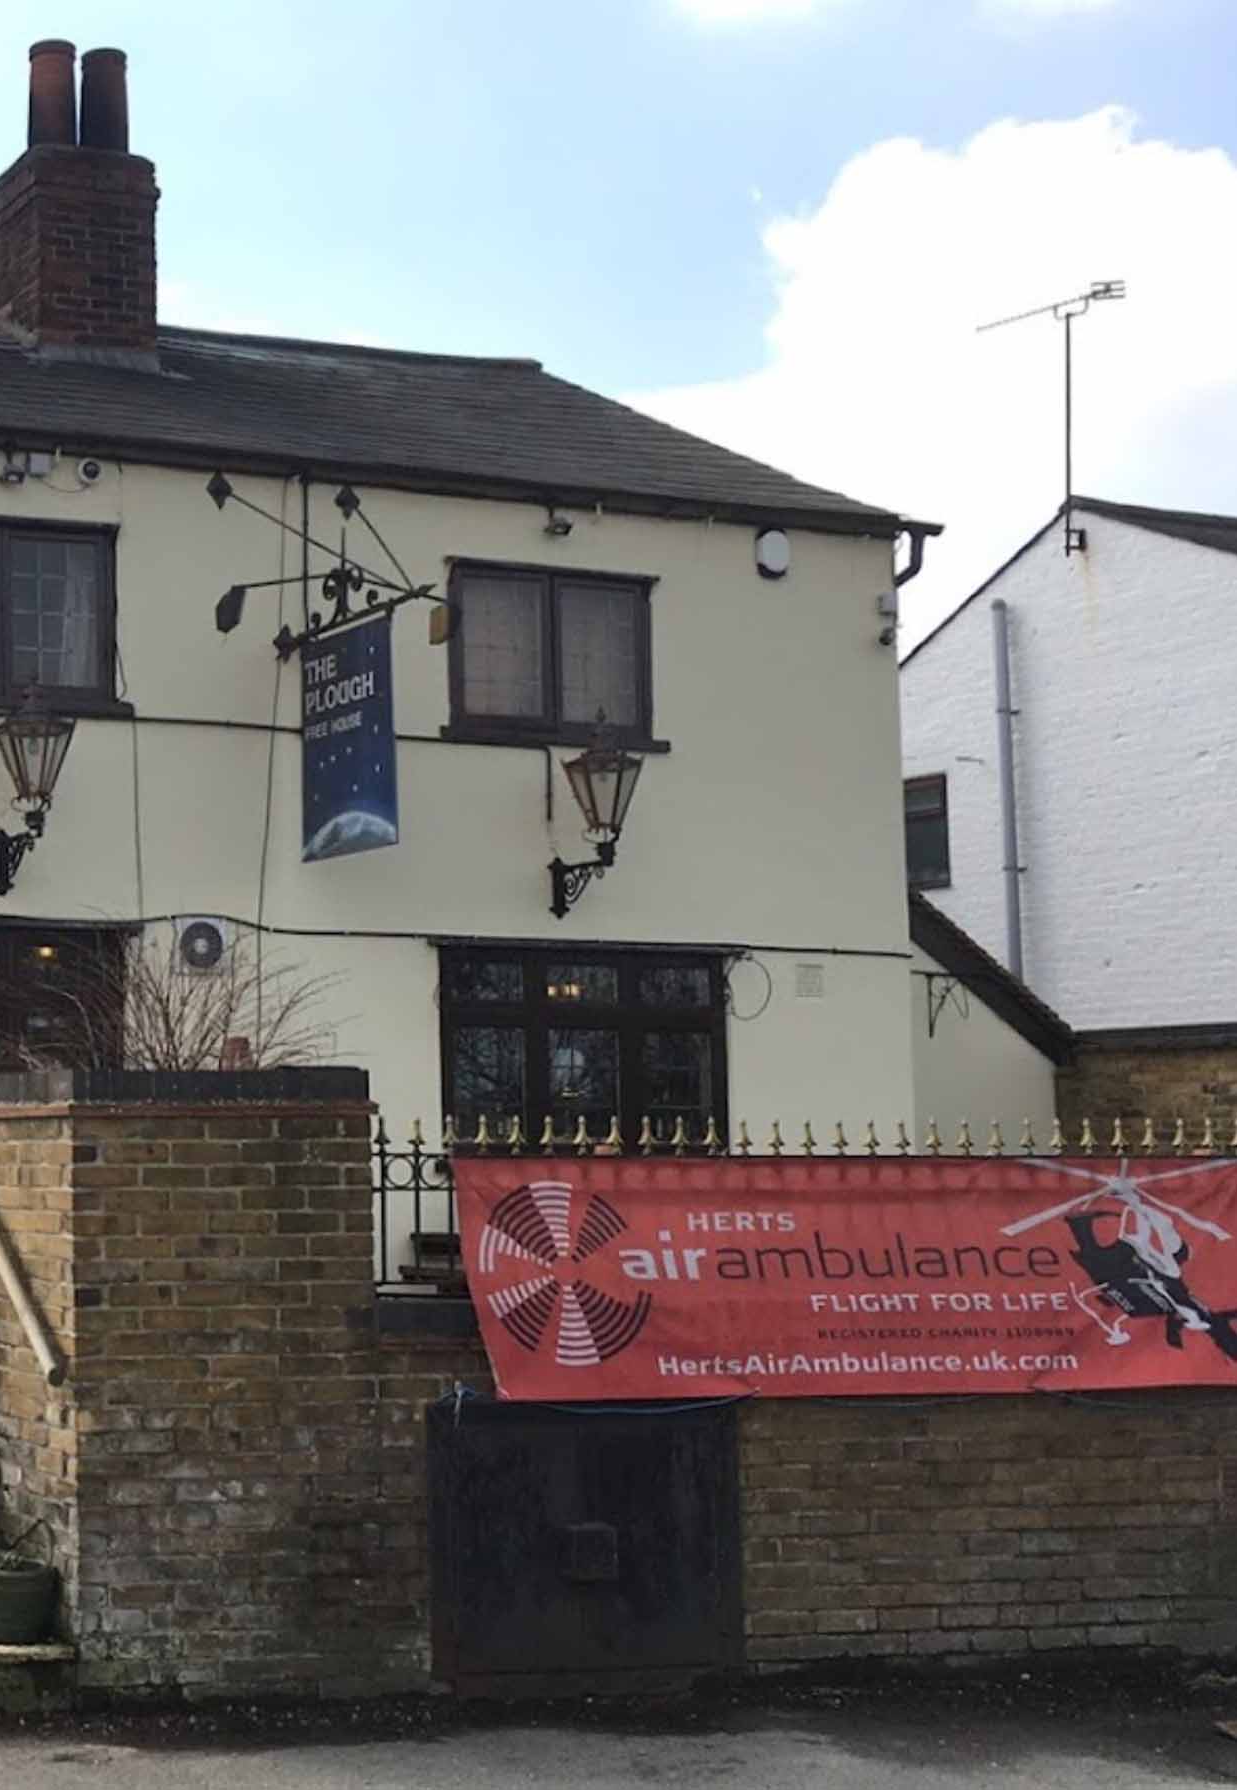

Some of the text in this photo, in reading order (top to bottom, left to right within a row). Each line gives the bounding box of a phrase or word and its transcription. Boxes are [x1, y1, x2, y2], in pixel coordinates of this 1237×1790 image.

[305, 654, 338, 685] THE
[306, 671, 374, 715] PLOUGH
[688, 1212, 795, 1232] HERTS
[811, 1292, 1068, 1313] FLIGHT FOR LIFE
[658, 1350, 1078, 1376] HertsAirAmbulance.uk.com
